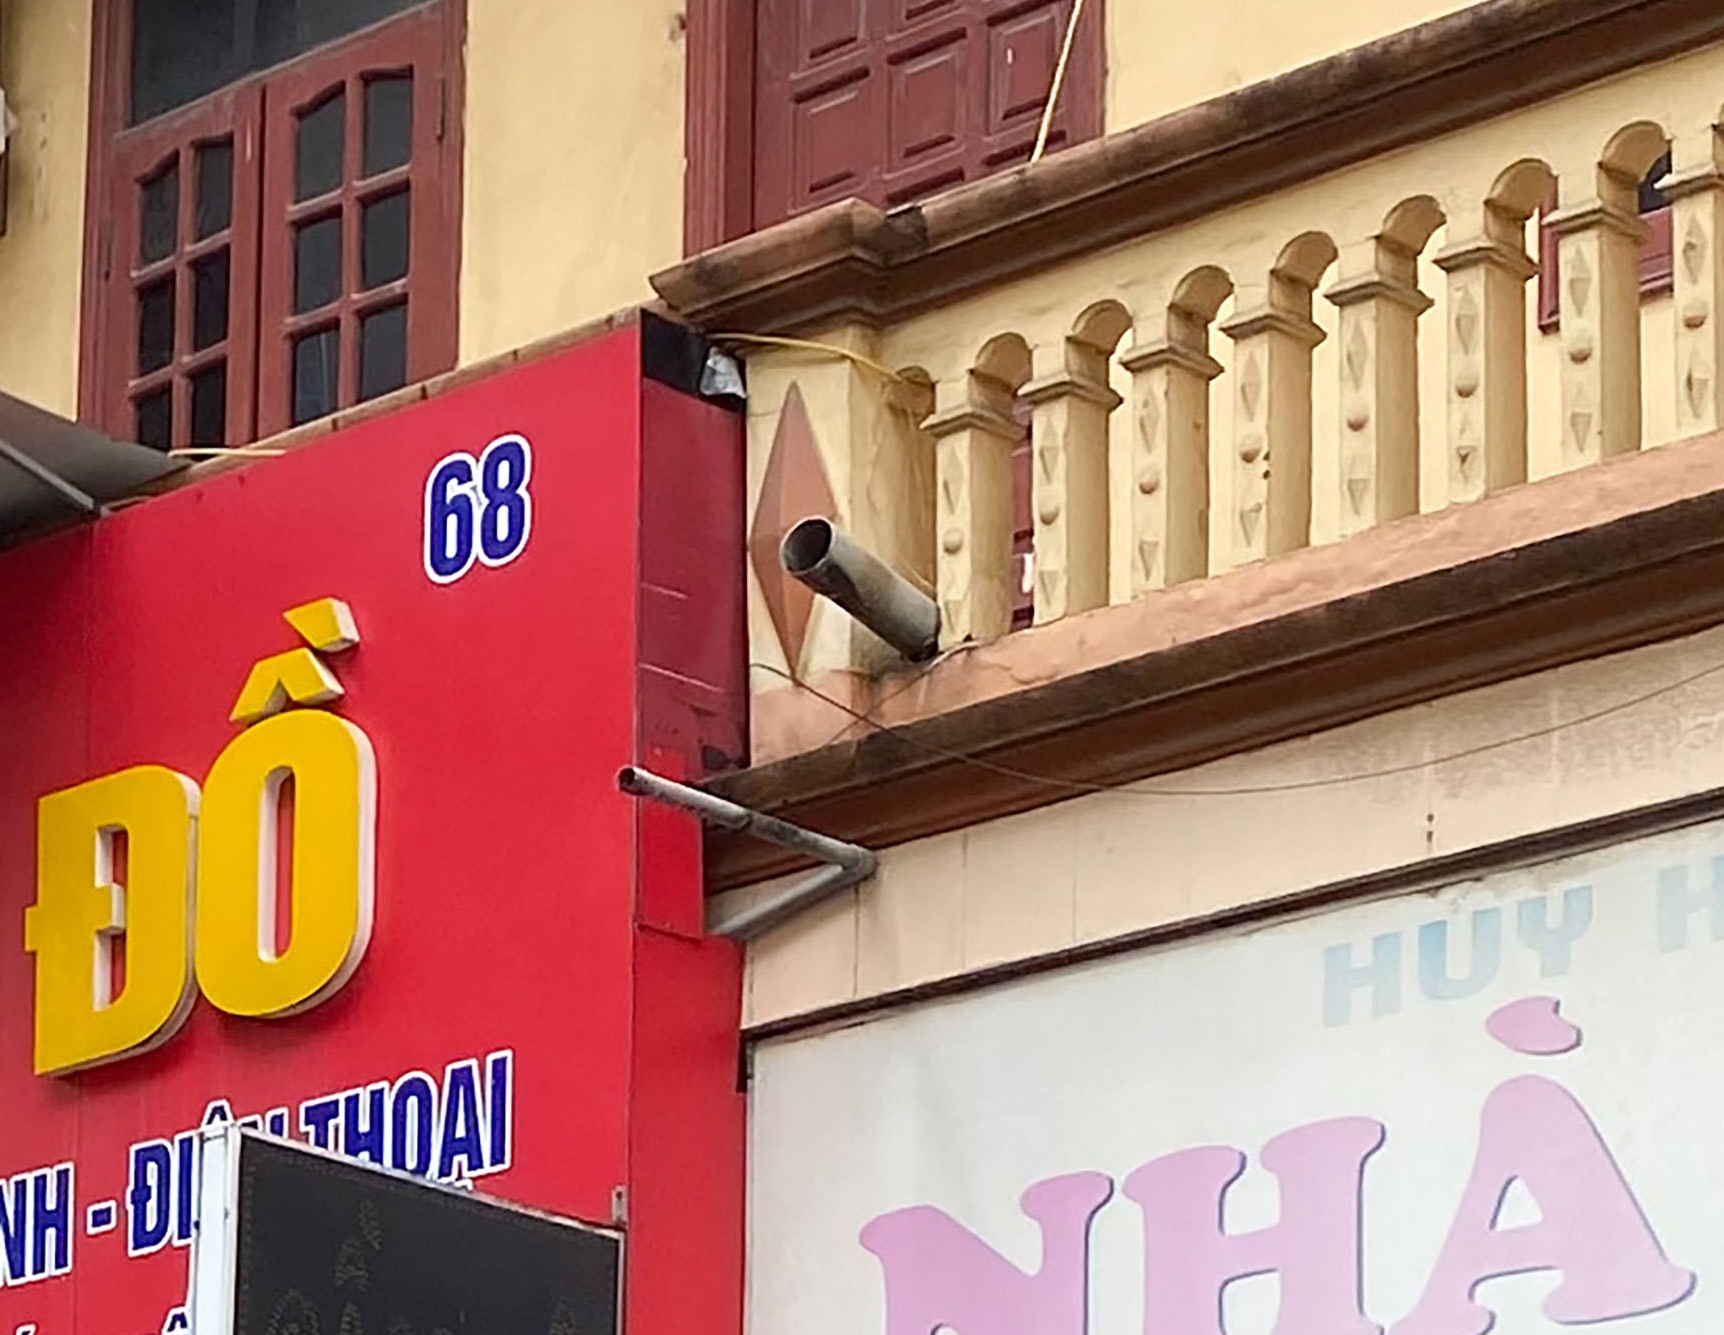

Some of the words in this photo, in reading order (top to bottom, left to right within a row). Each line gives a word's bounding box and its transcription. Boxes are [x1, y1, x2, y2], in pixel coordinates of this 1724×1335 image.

[422, 432, 531, 585] 68
[24, 596, 379, 1080] ĐỒ
[1323, 885, 1592, 1027] HUY
